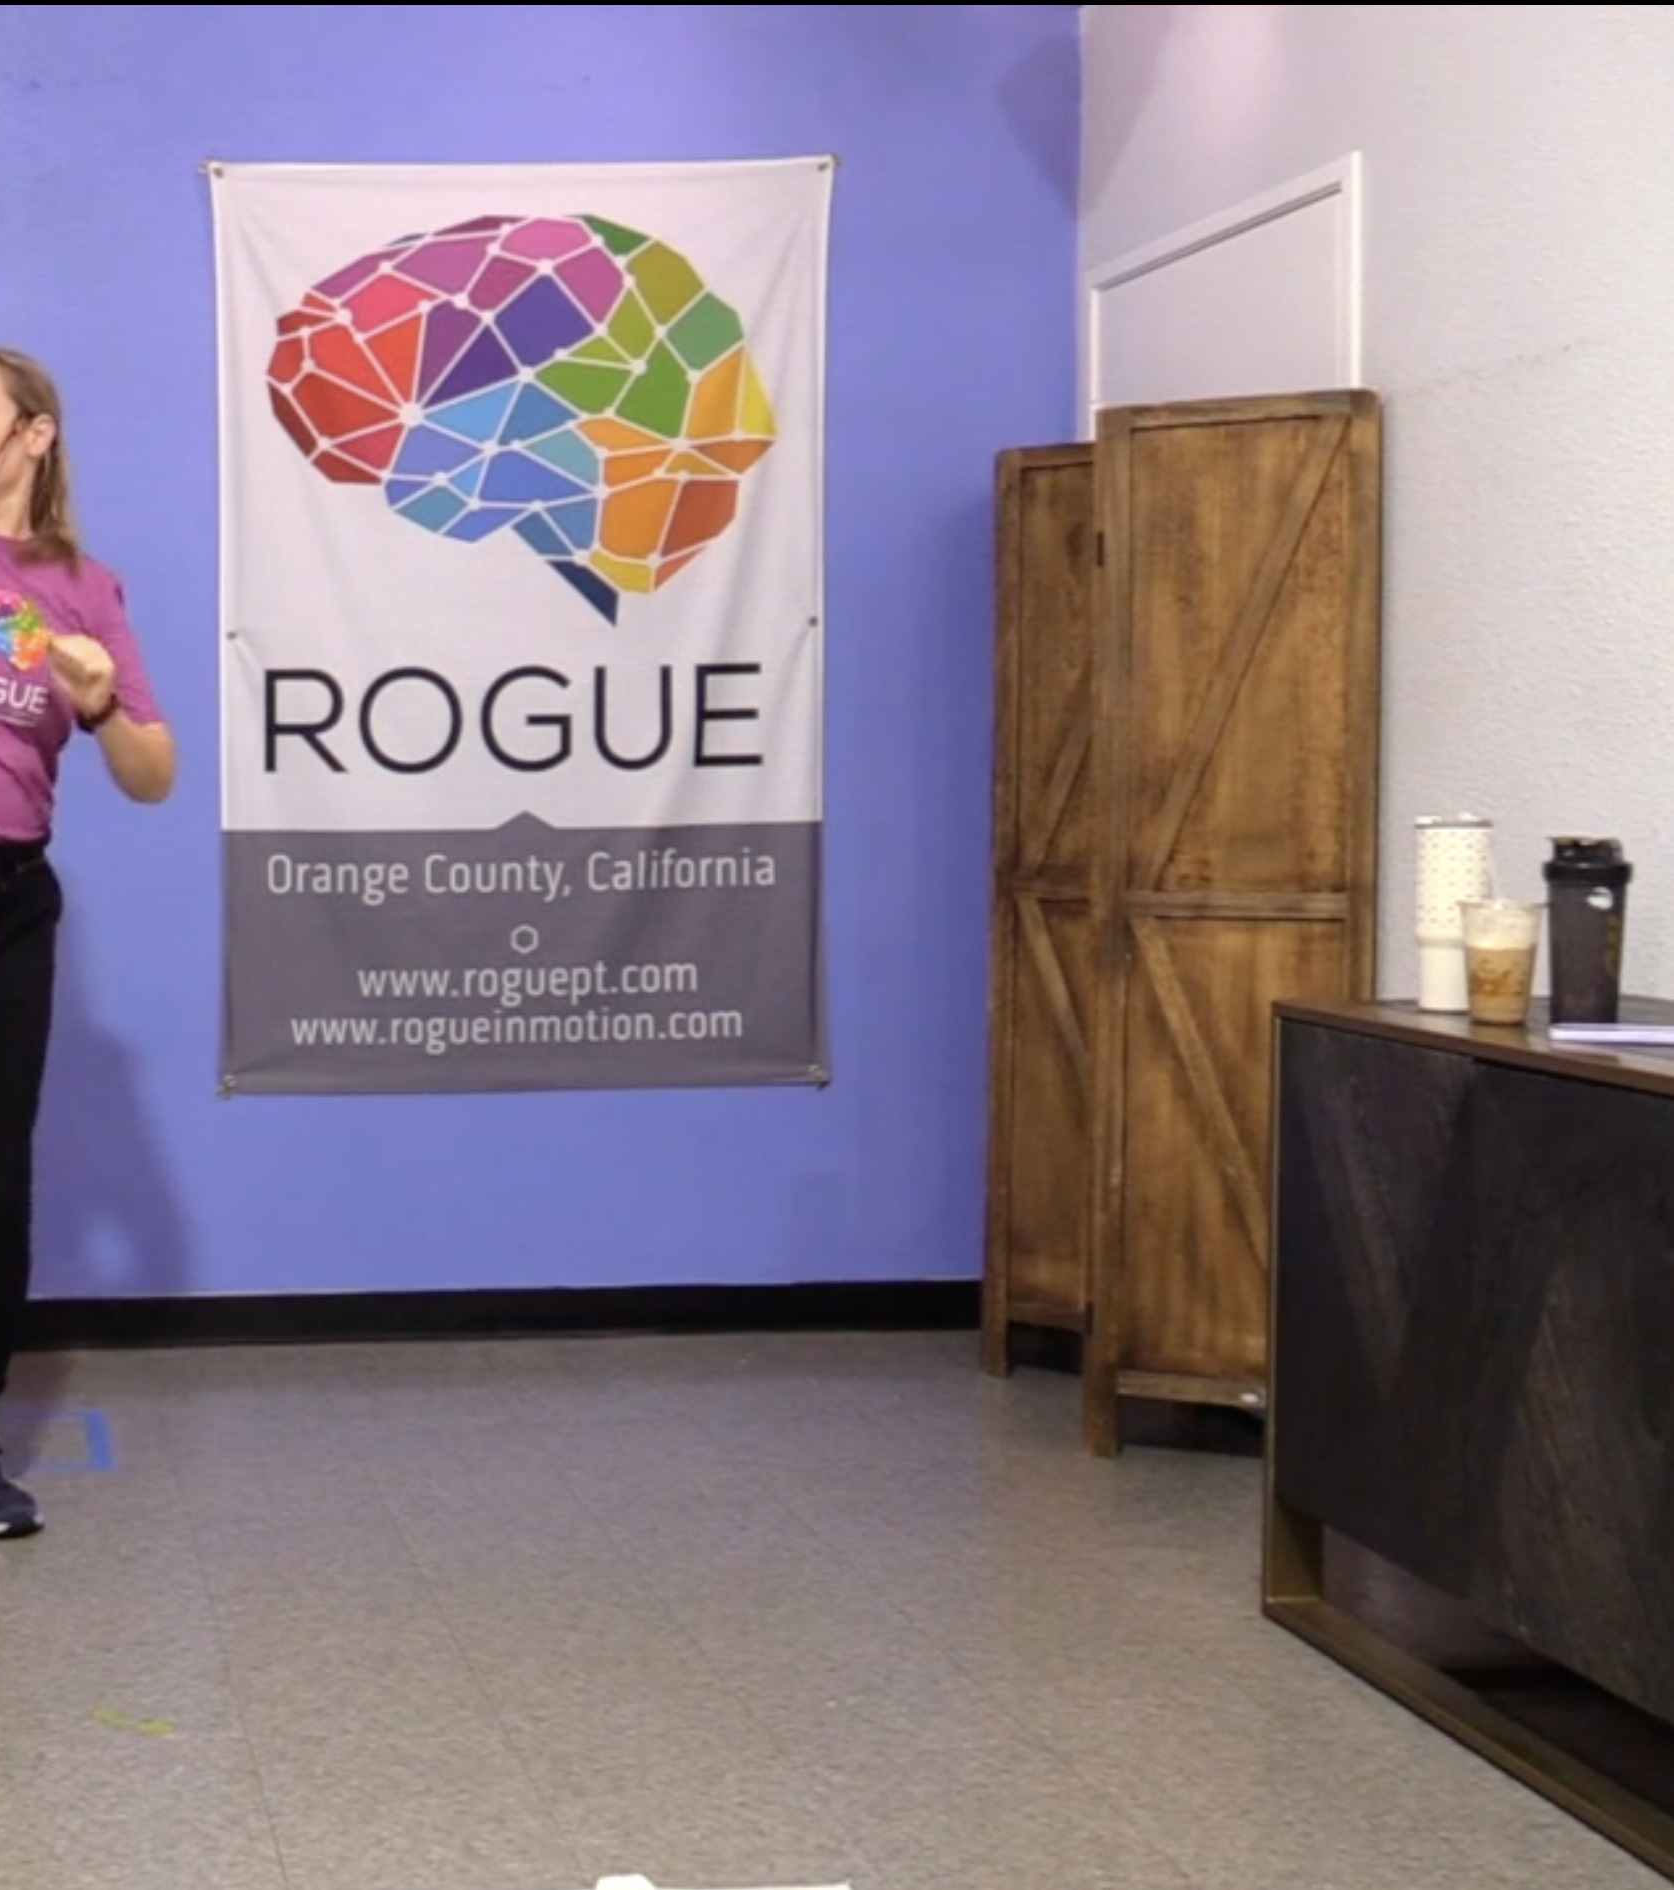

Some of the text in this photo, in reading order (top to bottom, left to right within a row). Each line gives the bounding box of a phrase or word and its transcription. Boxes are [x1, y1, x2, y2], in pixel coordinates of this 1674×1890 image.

[264, 662, 764, 775] ROGUE
[266, 847, 776, 906] Orange County, California
[357, 960, 699, 1007] www.roguept.com
[290, 1008, 743, 1055] www.rogueinmotion.com
